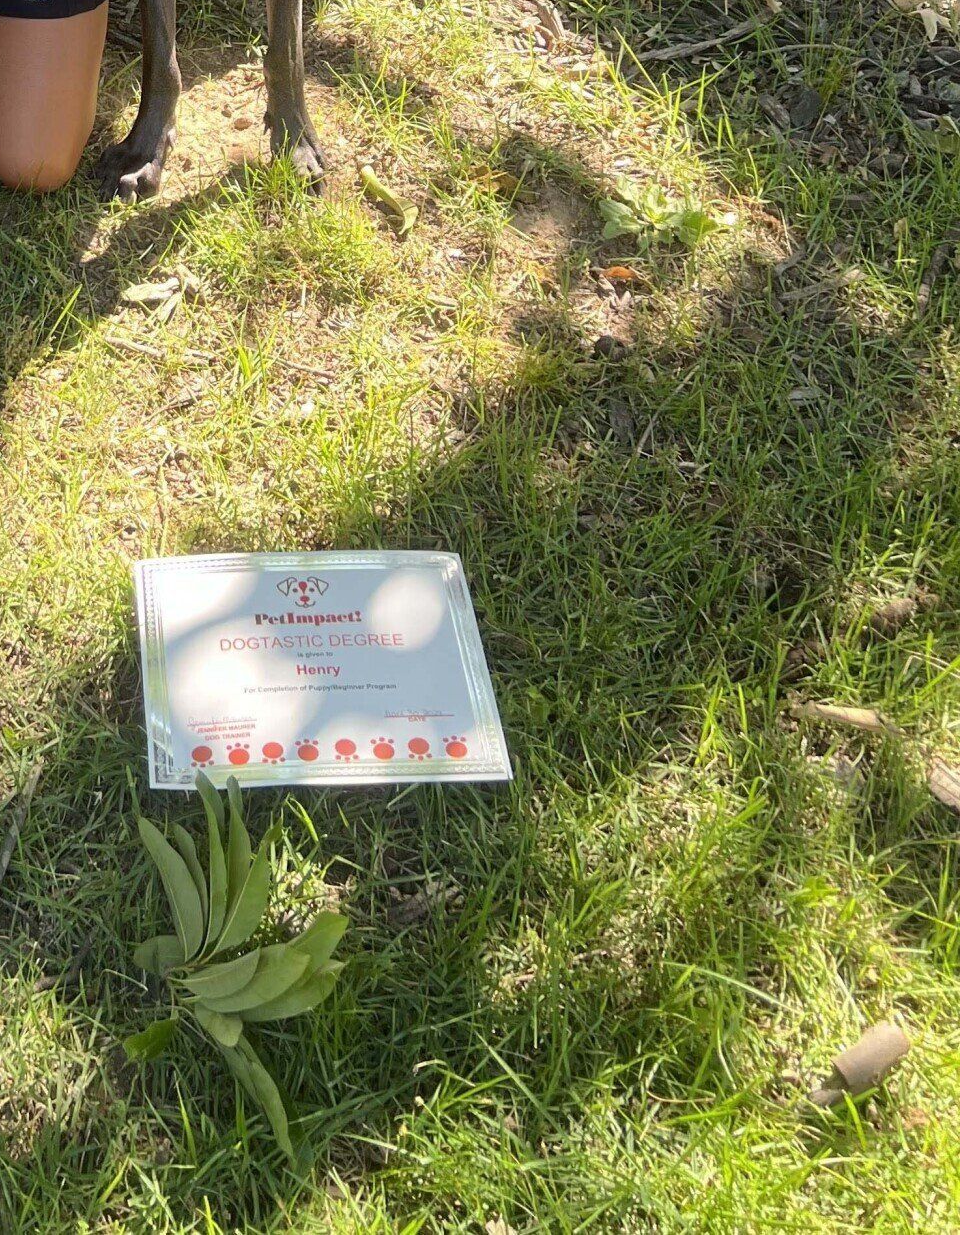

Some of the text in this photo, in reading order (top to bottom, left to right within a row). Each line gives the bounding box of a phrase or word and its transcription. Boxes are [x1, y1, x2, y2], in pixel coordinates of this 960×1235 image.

[255, 610, 362, 626] PetImpact!
[220, 633, 405, 651] DOGTASTIC DEGREE
[296, 664, 340, 677] Henry
[258, 685, 299, 694] Completion
[366, 683, 397, 691] Program
